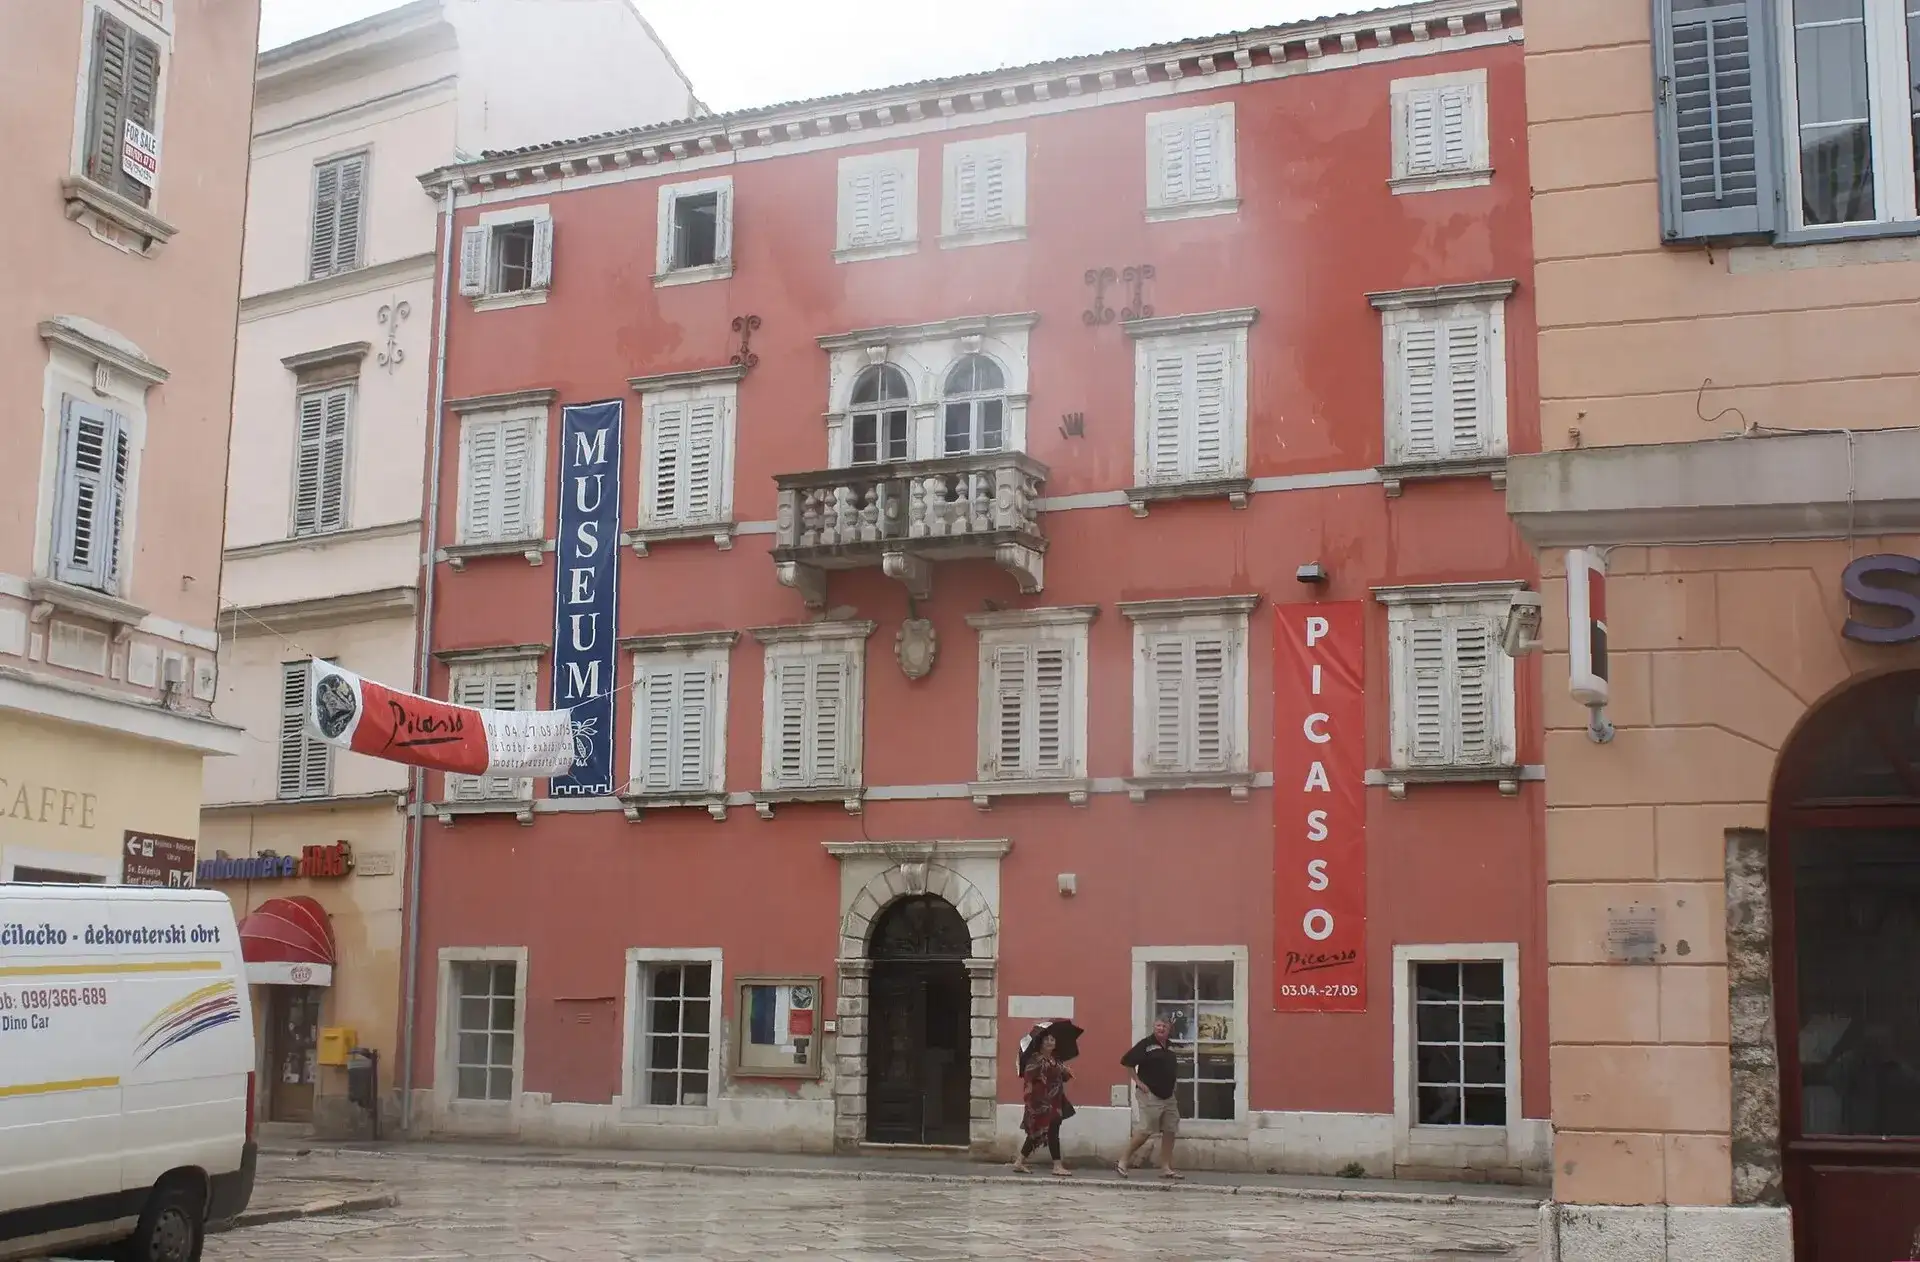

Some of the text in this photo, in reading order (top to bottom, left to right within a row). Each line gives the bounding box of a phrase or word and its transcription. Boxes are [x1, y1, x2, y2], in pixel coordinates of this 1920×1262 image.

[126, 123, 140, 145] FOR
[140, 131, 156, 154] SALE
[564, 428, 609, 699] MUSEUM
[1303, 616, 1334, 941] PICASSO
[85, 923, 186, 945] dekoraterski
[191, 924, 220, 943] obrt
[21, 987, 107, 1009] 098/366-689
[1281, 984, 1358, 996] 03.04.-27.09
[2, 1014, 49, 1031] Dino Car
